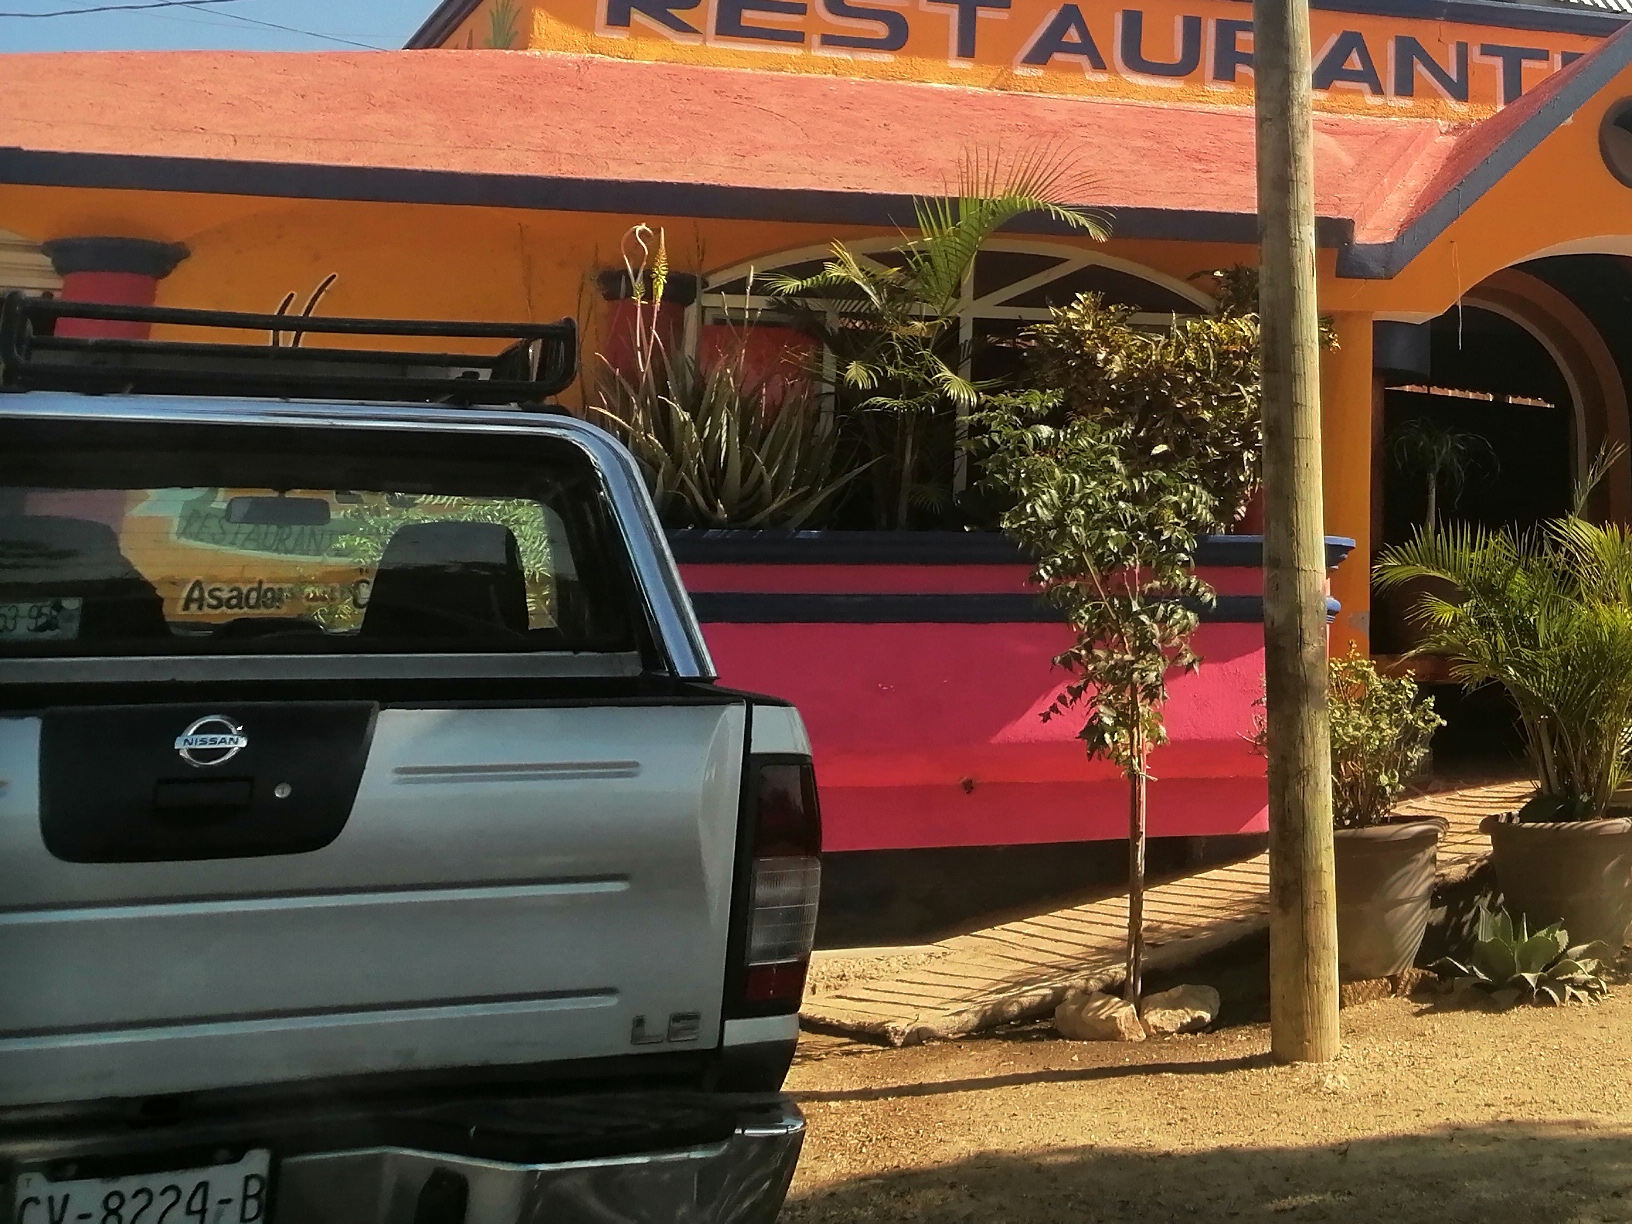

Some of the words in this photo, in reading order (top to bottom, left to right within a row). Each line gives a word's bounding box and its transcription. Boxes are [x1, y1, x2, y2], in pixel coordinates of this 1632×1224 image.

[182, 580, 287, 613] Asador
[183, 737, 239, 746] NISSAN
[630, 1011, 702, 1045] LE
